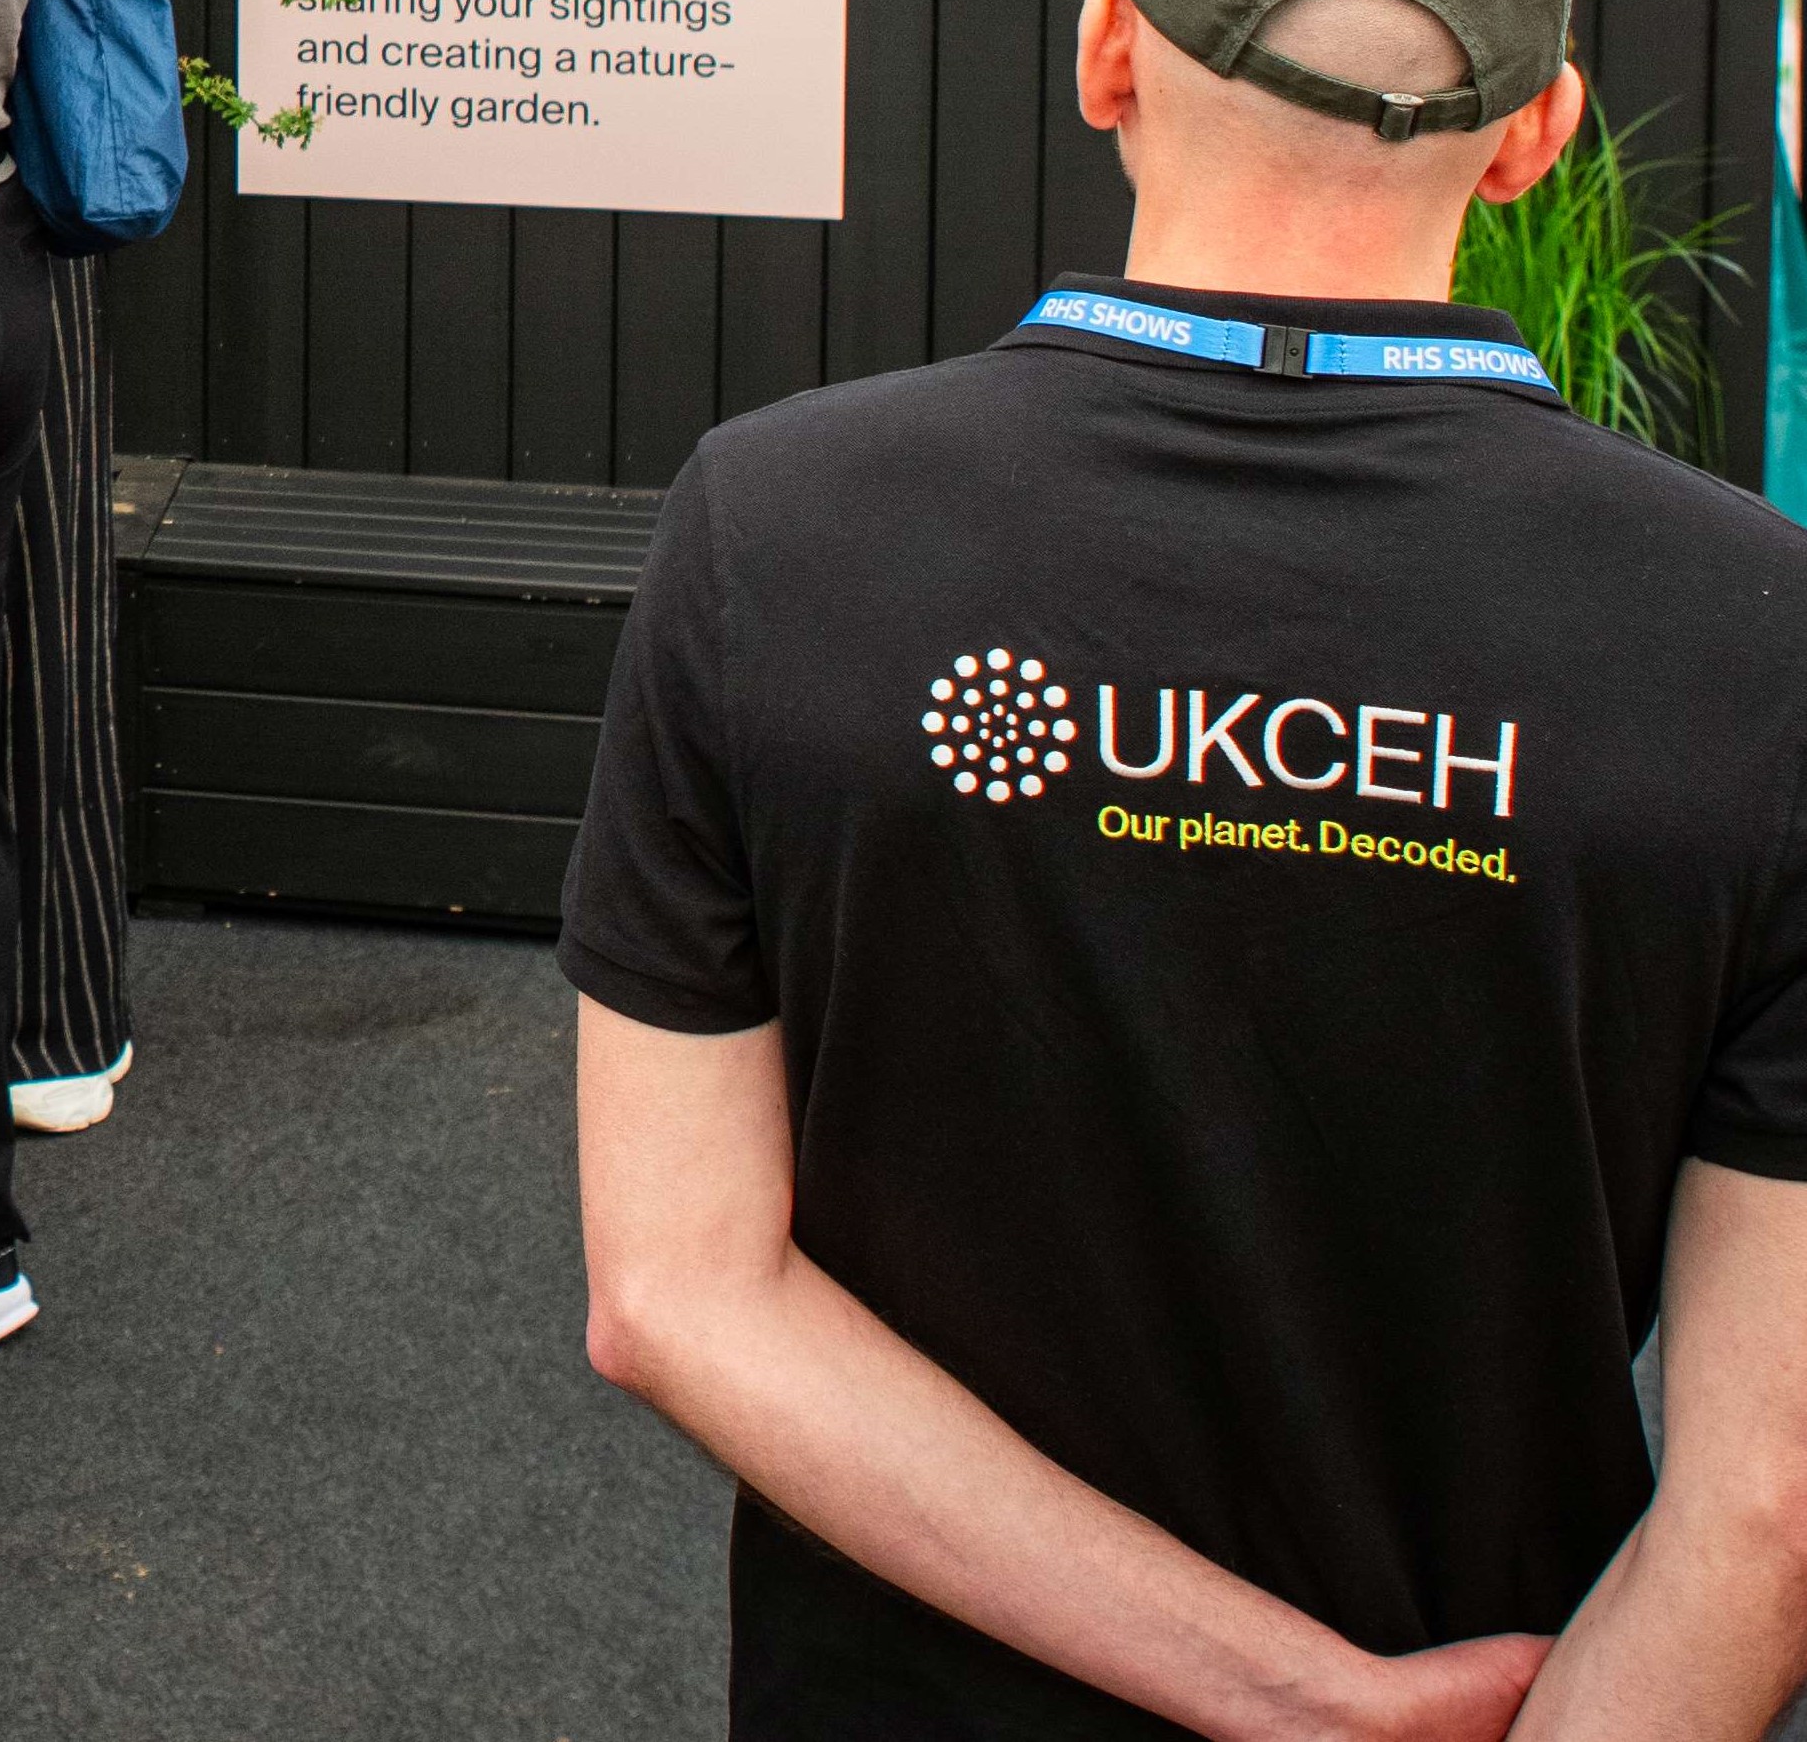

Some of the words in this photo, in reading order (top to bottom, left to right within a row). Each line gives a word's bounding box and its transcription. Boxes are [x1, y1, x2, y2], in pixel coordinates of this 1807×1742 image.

[297, 33, 369, 65] and
[380, 36, 542, 79] creating
[554, 47, 578, 74] a
[589, 43, 736, 79] nature-
[297, 83, 440, 126] friendly
[450, 90, 601, 130] garden.
[1039, 296, 1084, 323] RHS
[1088, 301, 1191, 347] SHOWS
[1383, 344, 1442, 371] RHS
[1449, 345, 1543, 380] SHOWS
[1098, 683, 1518, 817] UKCEH
[1097, 804, 1169, 842] Our
[1179, 811, 1311, 854] planet.
[1319, 819, 1518, 884] Decoded.
